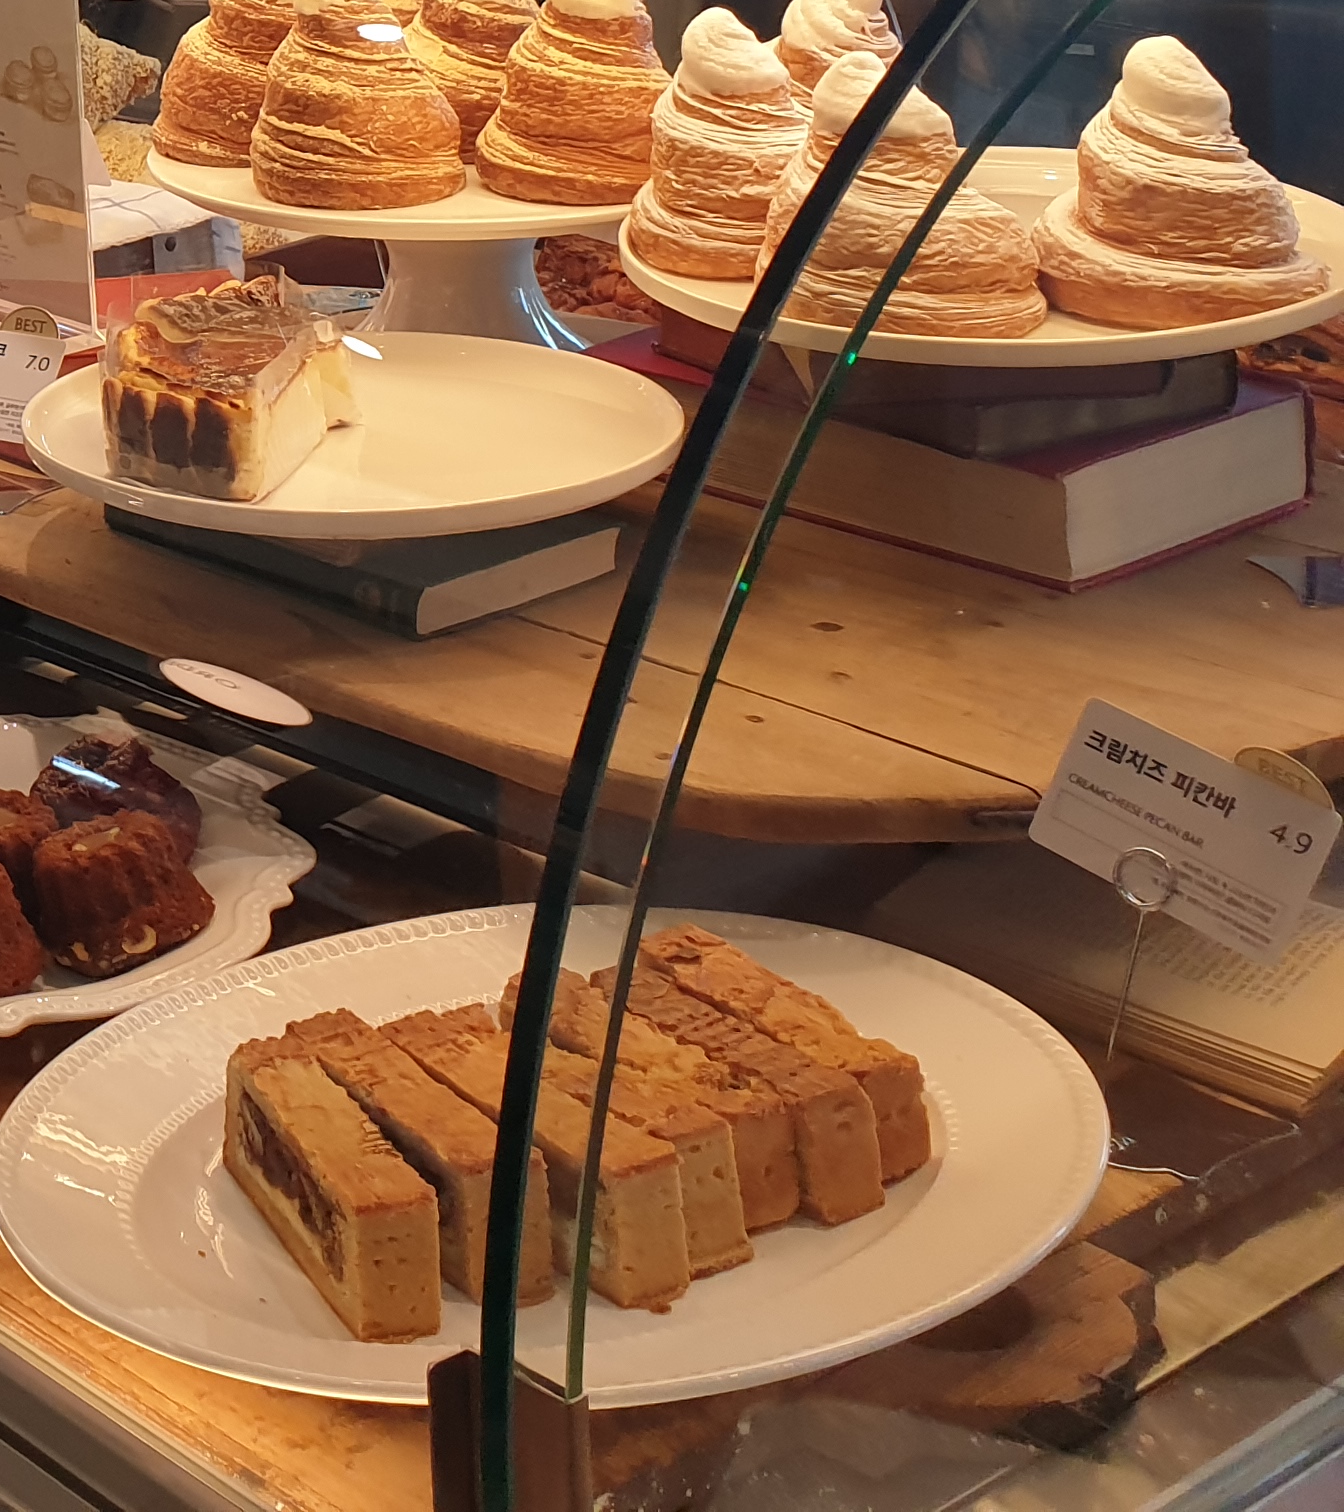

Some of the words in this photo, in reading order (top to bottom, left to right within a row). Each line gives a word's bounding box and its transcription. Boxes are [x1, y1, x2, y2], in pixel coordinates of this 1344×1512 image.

[14, 316, 47, 335] BEST
[25, 354, 51, 372] 7.0
[1083, 729, 1168, 784] 크림치즈
[1170, 770, 1237, 819] 피칸바
[1269, 823, 1314, 855] 4.9
